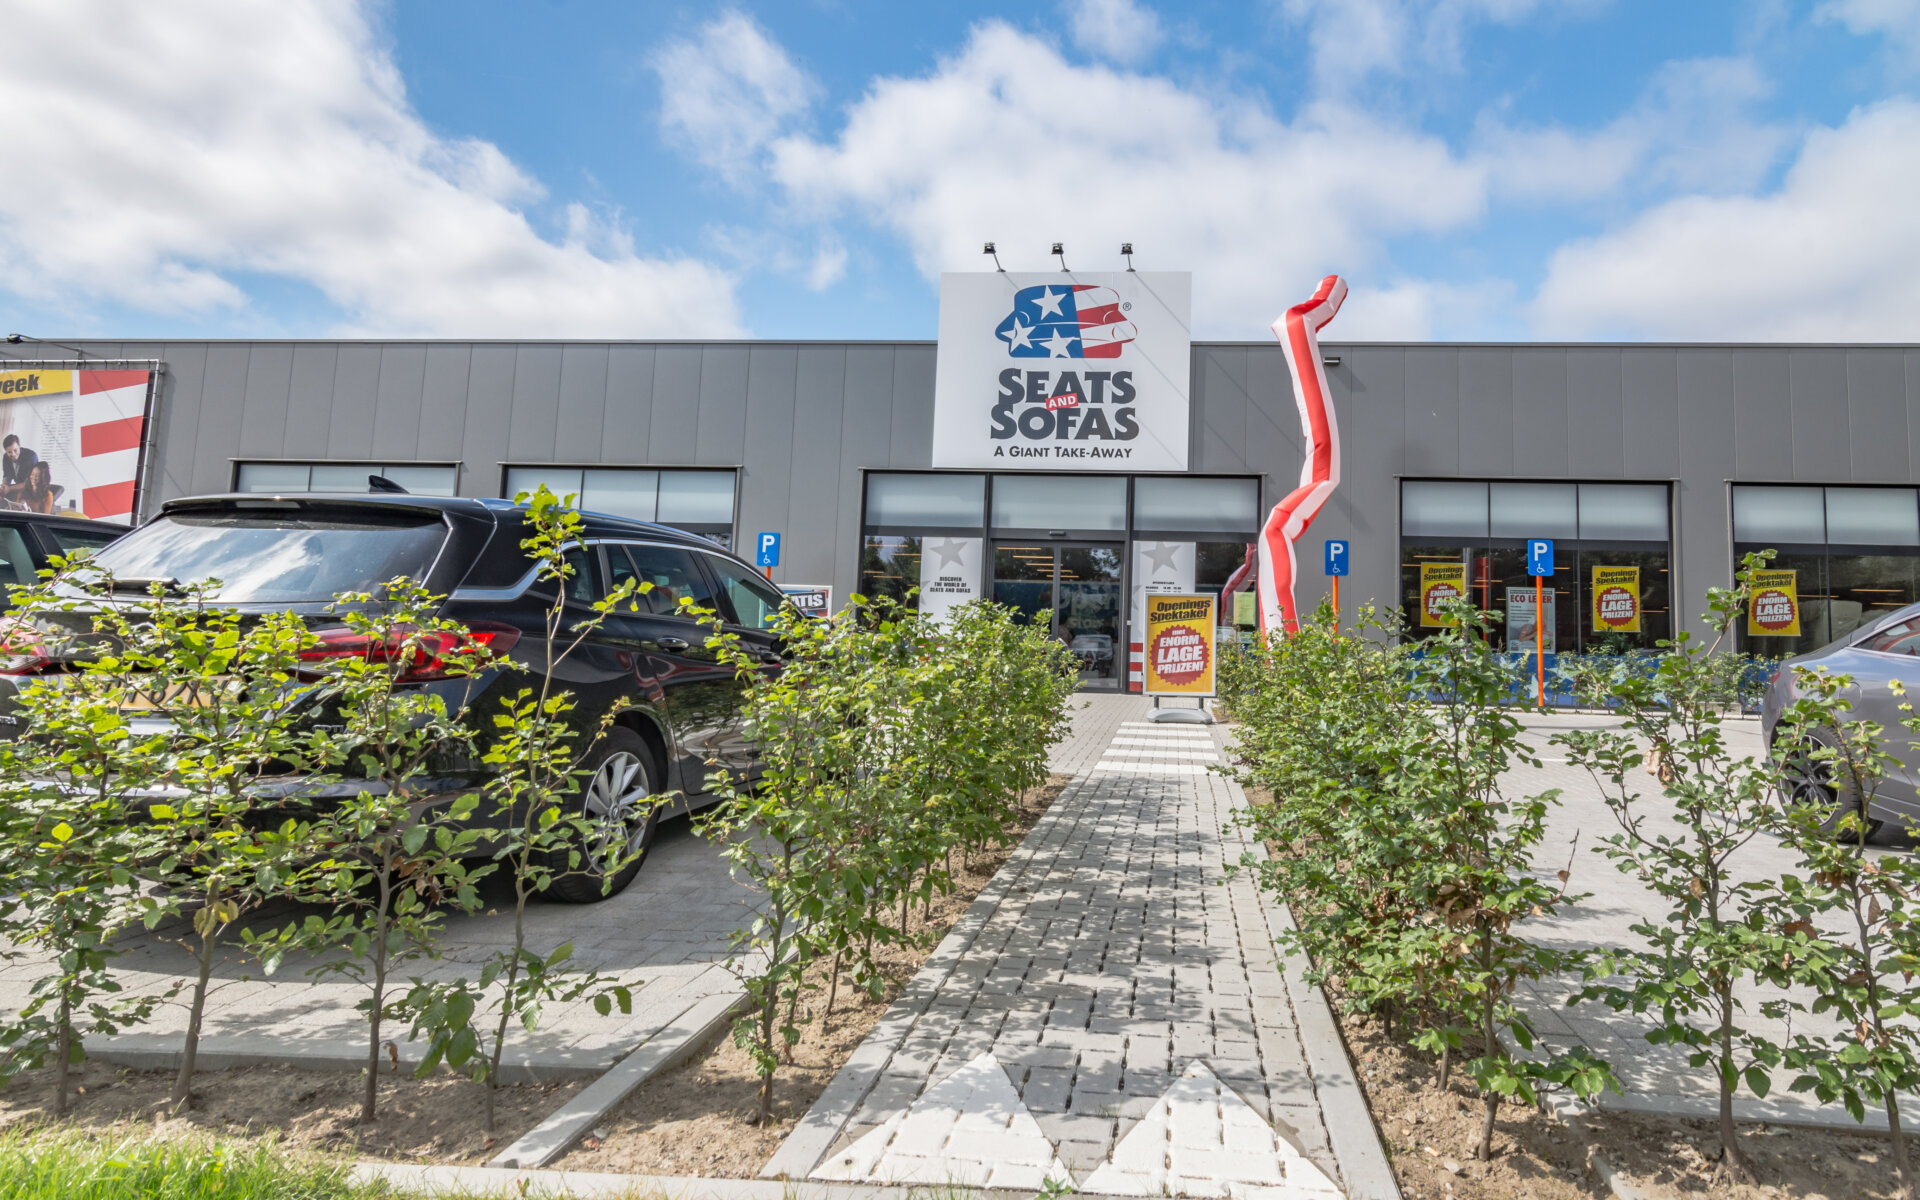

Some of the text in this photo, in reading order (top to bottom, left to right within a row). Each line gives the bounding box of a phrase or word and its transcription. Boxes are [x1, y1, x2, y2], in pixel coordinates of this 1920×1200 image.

[0, 374, 40, 394] eek
[998, 368, 1136, 404] SEATS
[1048, 396, 1076, 408] AND
[990, 402, 1139, 440] SOFAS
[994, 446, 1132, 458] A GIANT TAKE-AWAY
[762, 535, 775, 552] P
[1331, 543, 1343, 561] P
[1534, 542, 1547, 561] P
[792, 594, 824, 607] ATIS
[1528, 595, 1552, 603] LEER
[1602, 600, 1633, 611] LAGE
[1157, 600, 1211, 612] Openings
[1756, 604, 1791, 615] LAGE
[1150, 608, 1207, 622] Spektakel
[1160, 635, 1200, 647] ENORM
[1157, 646, 1204, 663] LAGE
